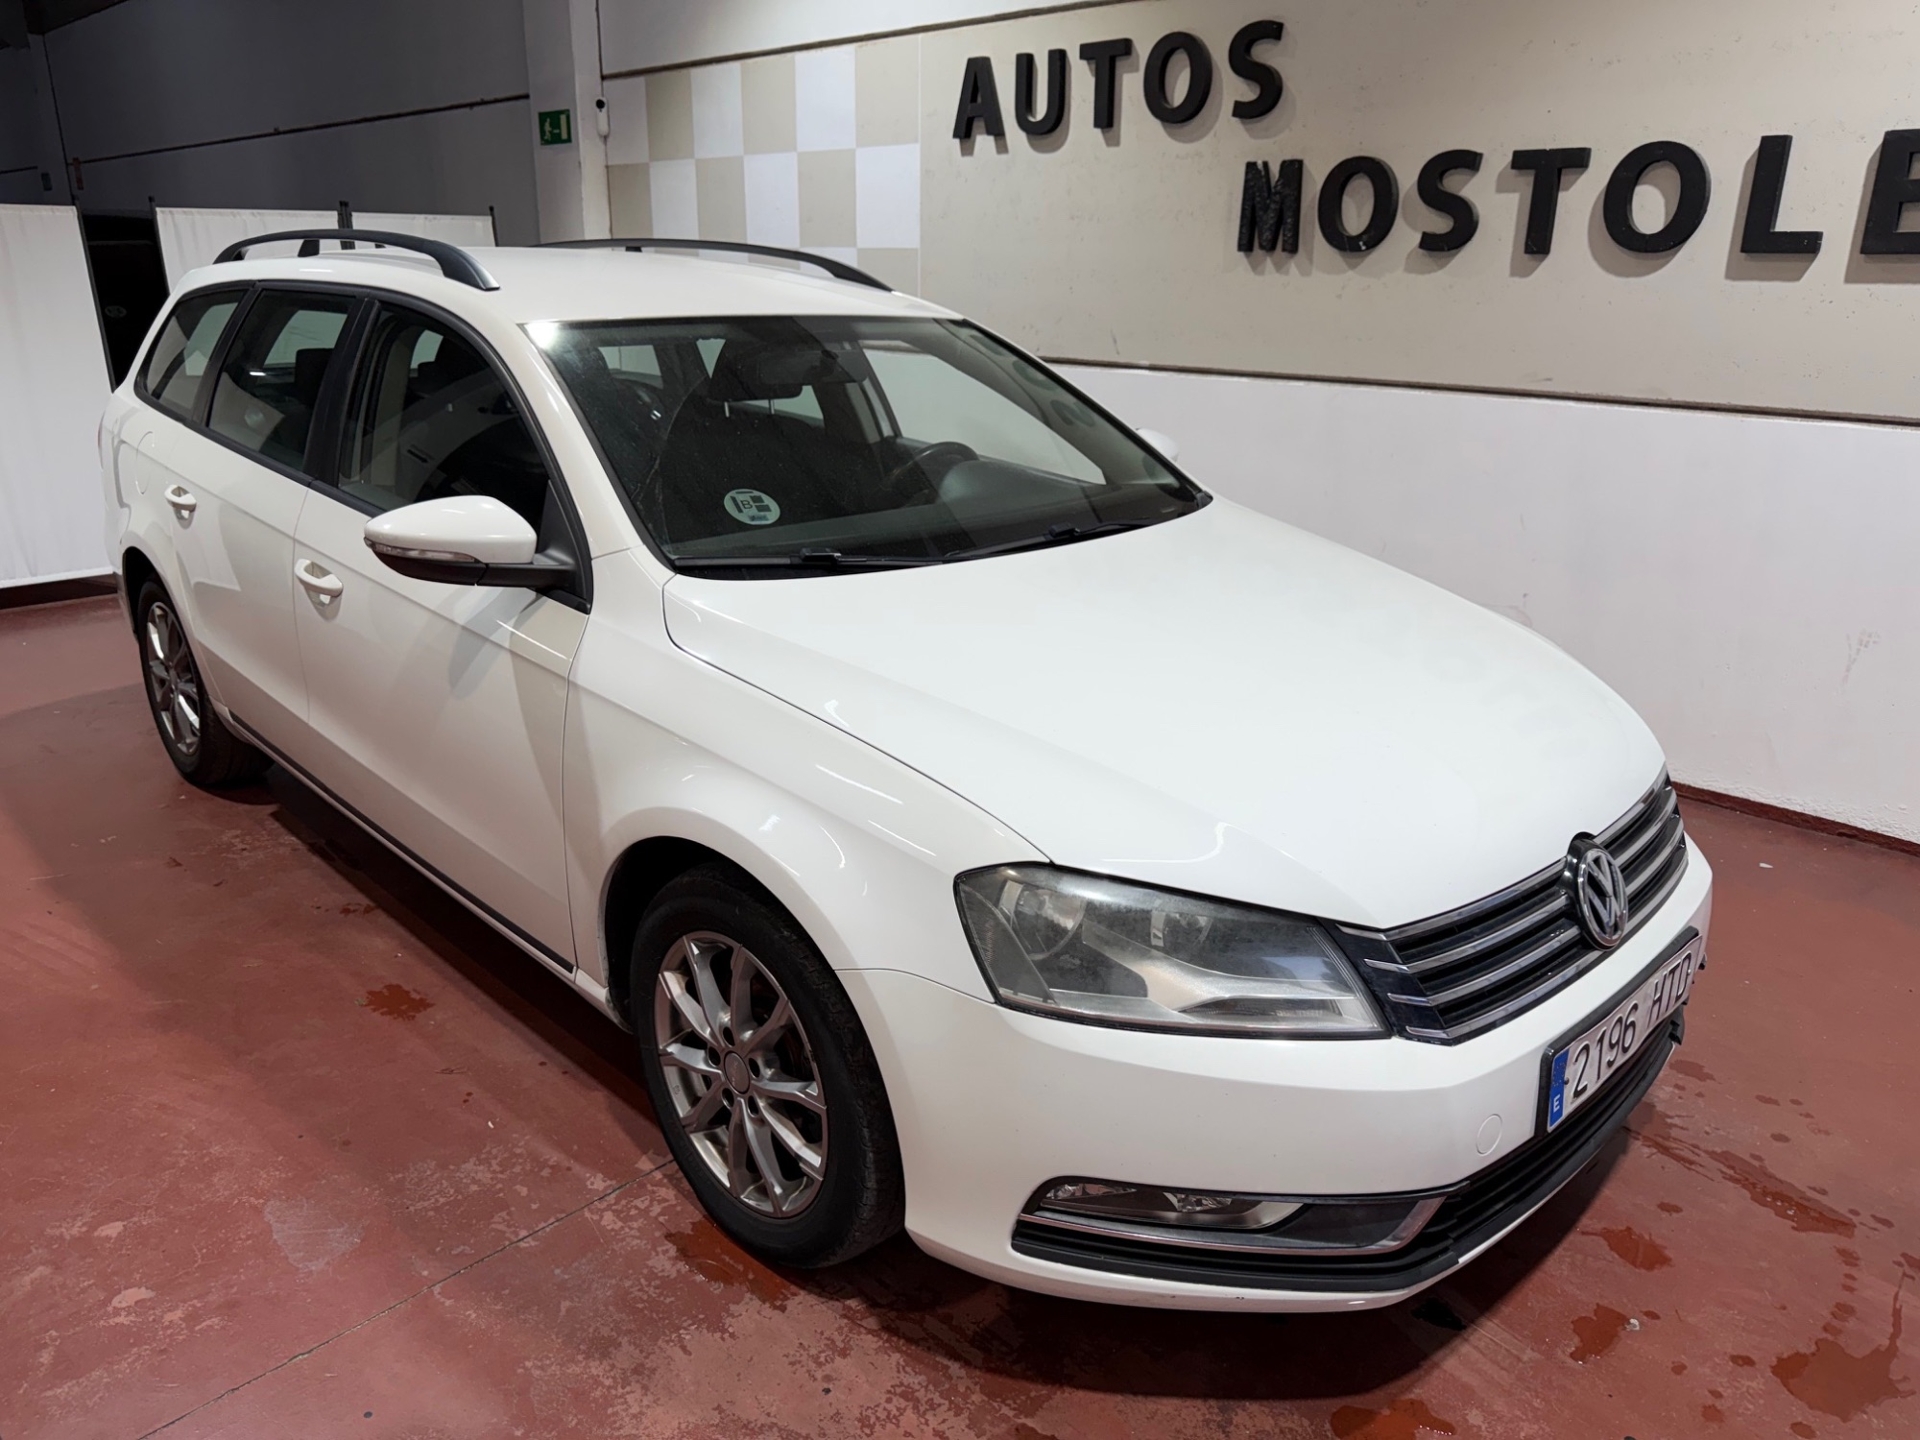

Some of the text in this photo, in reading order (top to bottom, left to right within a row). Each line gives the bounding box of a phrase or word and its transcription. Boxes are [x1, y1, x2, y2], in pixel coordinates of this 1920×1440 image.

[953, 20, 1285, 141] AUTOS
[1237, 129, 1920, 256] MOSTOLE
[741, 500, 753, 510] B
[1570, 951, 1692, 1104] 2196 HTD
[1553, 1094, 1560, 1112] E
